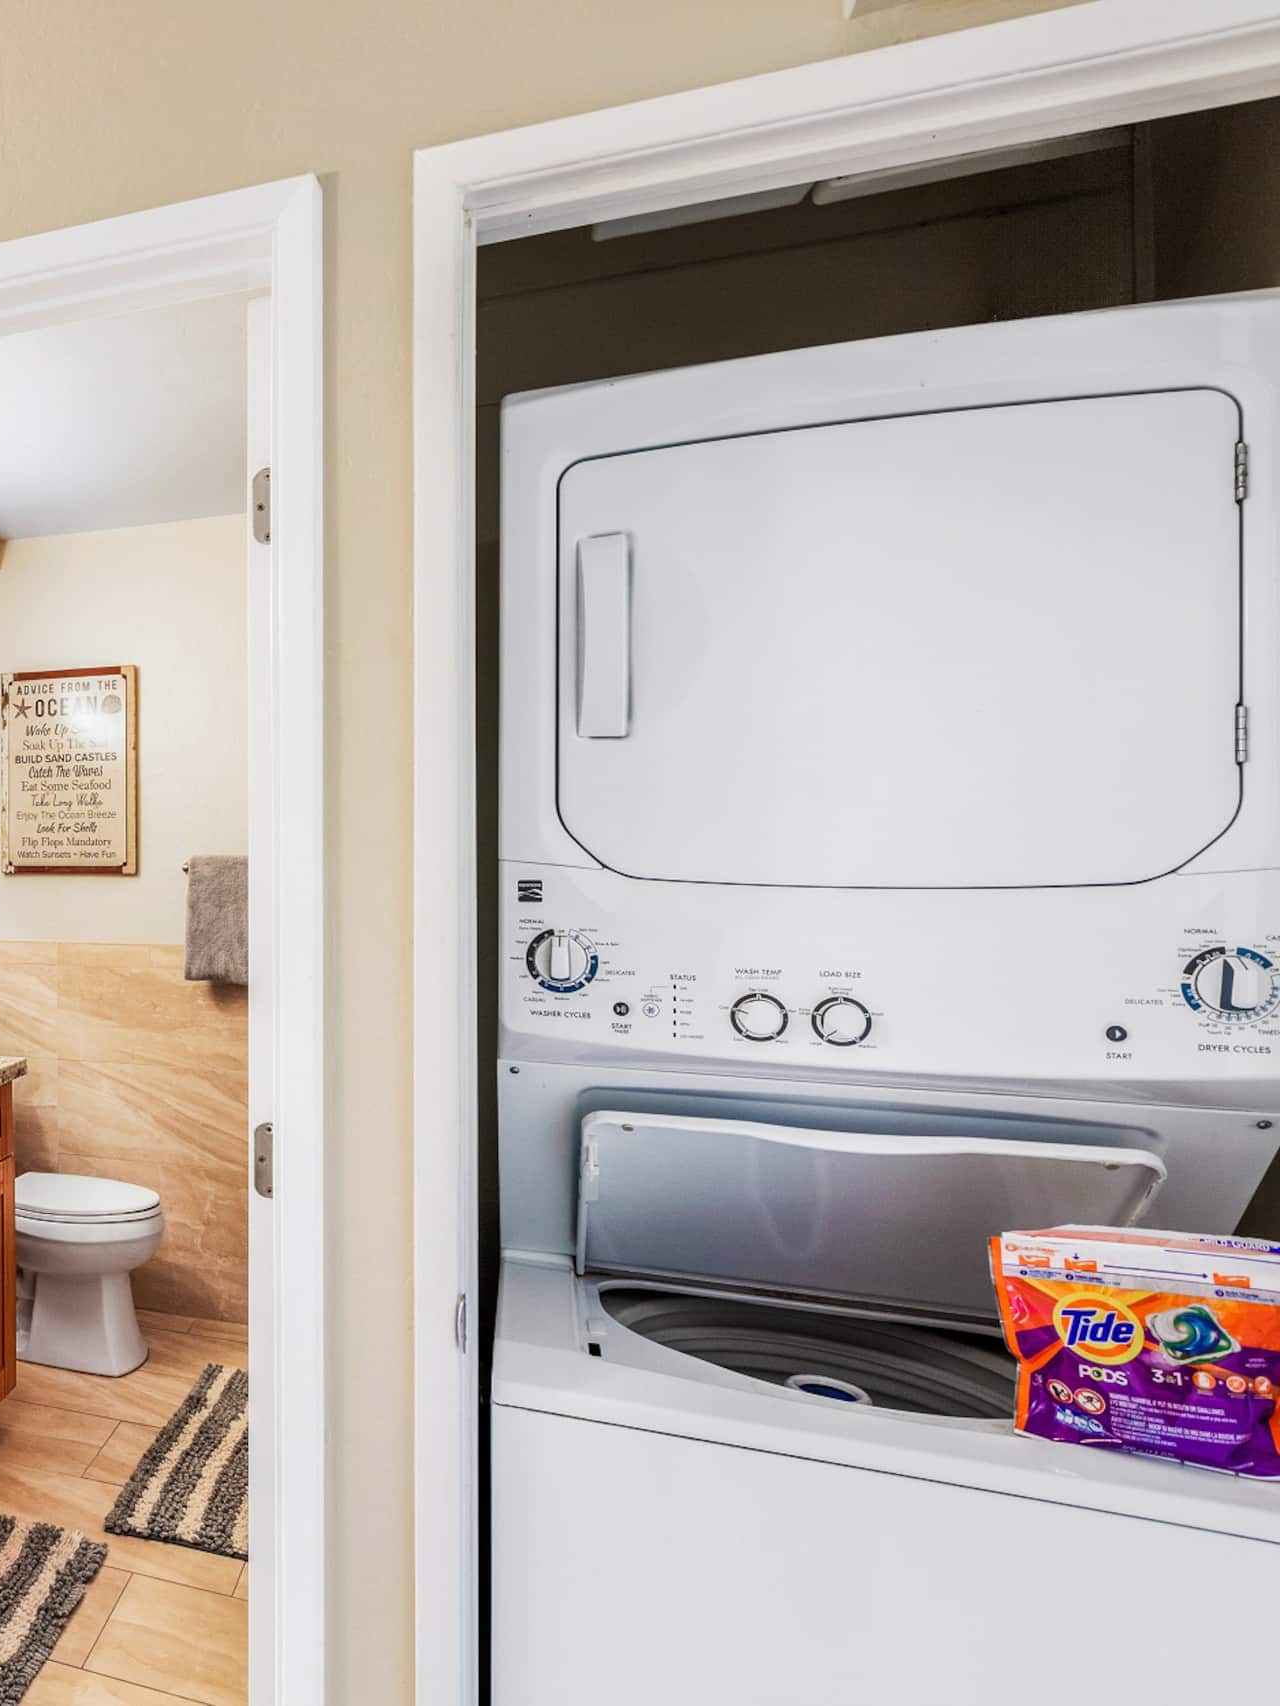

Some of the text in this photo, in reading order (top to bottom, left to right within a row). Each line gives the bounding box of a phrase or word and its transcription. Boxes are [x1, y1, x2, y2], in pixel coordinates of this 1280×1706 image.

[16, 679, 119, 696] ADVICE FROM THE
[34, 696, 98, 718] OCEAN
[25, 723, 52, 738] Wake
[54, 723, 68, 738] Up
[22, 739, 47, 751] Soak
[48, 739, 64, 752] Up
[15, 751, 118, 765] BUILD SAND CASTLES
[27, 764, 104, 779] Catch The Waves
[20, 779, 112, 792] Eat Some Seafood
[16, 810, 117, 822] Enjoy The Ocean Breeze
[36, 821, 98, 834] Look For Shells
[22, 836, 112, 848] Flip Flops Mandatory
[17, 849, 117, 859] Watch Sunsets Have Fun
[734, 967, 783, 976] WASH TEMP
[819, 970, 862, 979] LOAD SIZE
[669, 974, 697, 983] STATUS
[1124, 998, 1164, 1006] DELICATES
[529, 1009, 592, 1020] WASHER CYCLES
[611, 1022, 632, 1030] START
[1198, 1043, 1272, 1055] DRYER CYCLES
[1105, 1052, 1132, 1060] START
[1060, 1309, 1135, 1346] Tide
[1078, 1364, 1129, 1386] PODS
